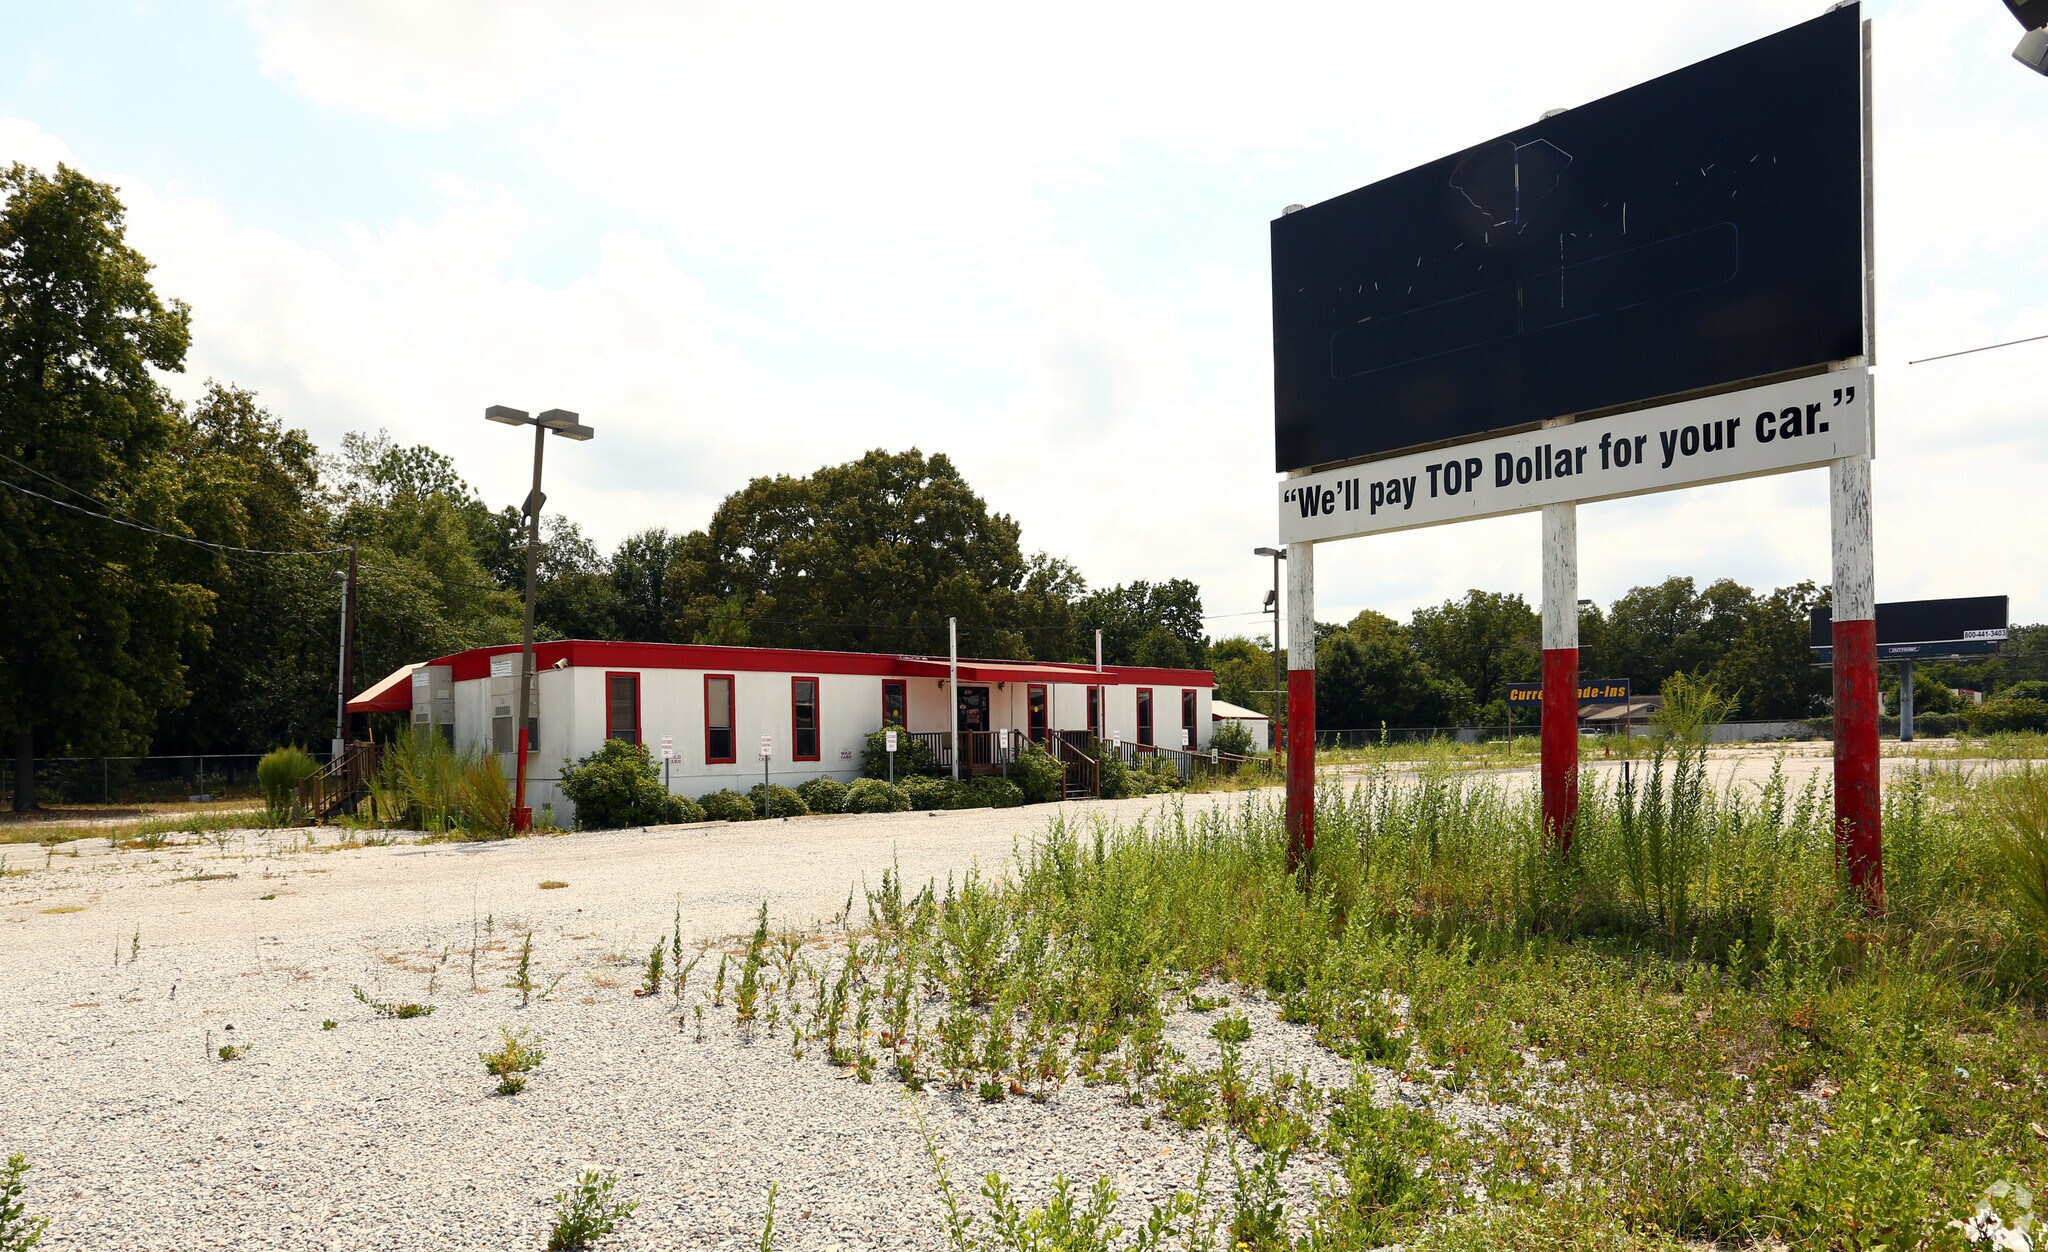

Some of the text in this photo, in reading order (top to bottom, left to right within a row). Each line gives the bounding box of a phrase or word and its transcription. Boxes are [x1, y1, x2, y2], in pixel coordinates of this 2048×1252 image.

[1370, 476, 1417, 516] pay
[1426, 457, 1483, 498] TOP
[1495, 443, 1588, 488] Dollar
[1599, 433, 1648, 470] for
[1660, 416, 1741, 470] your
[1964, 629, 2006, 639] 800-441-3403
[1510, 685, 1626, 701] Curre ade-Ins
